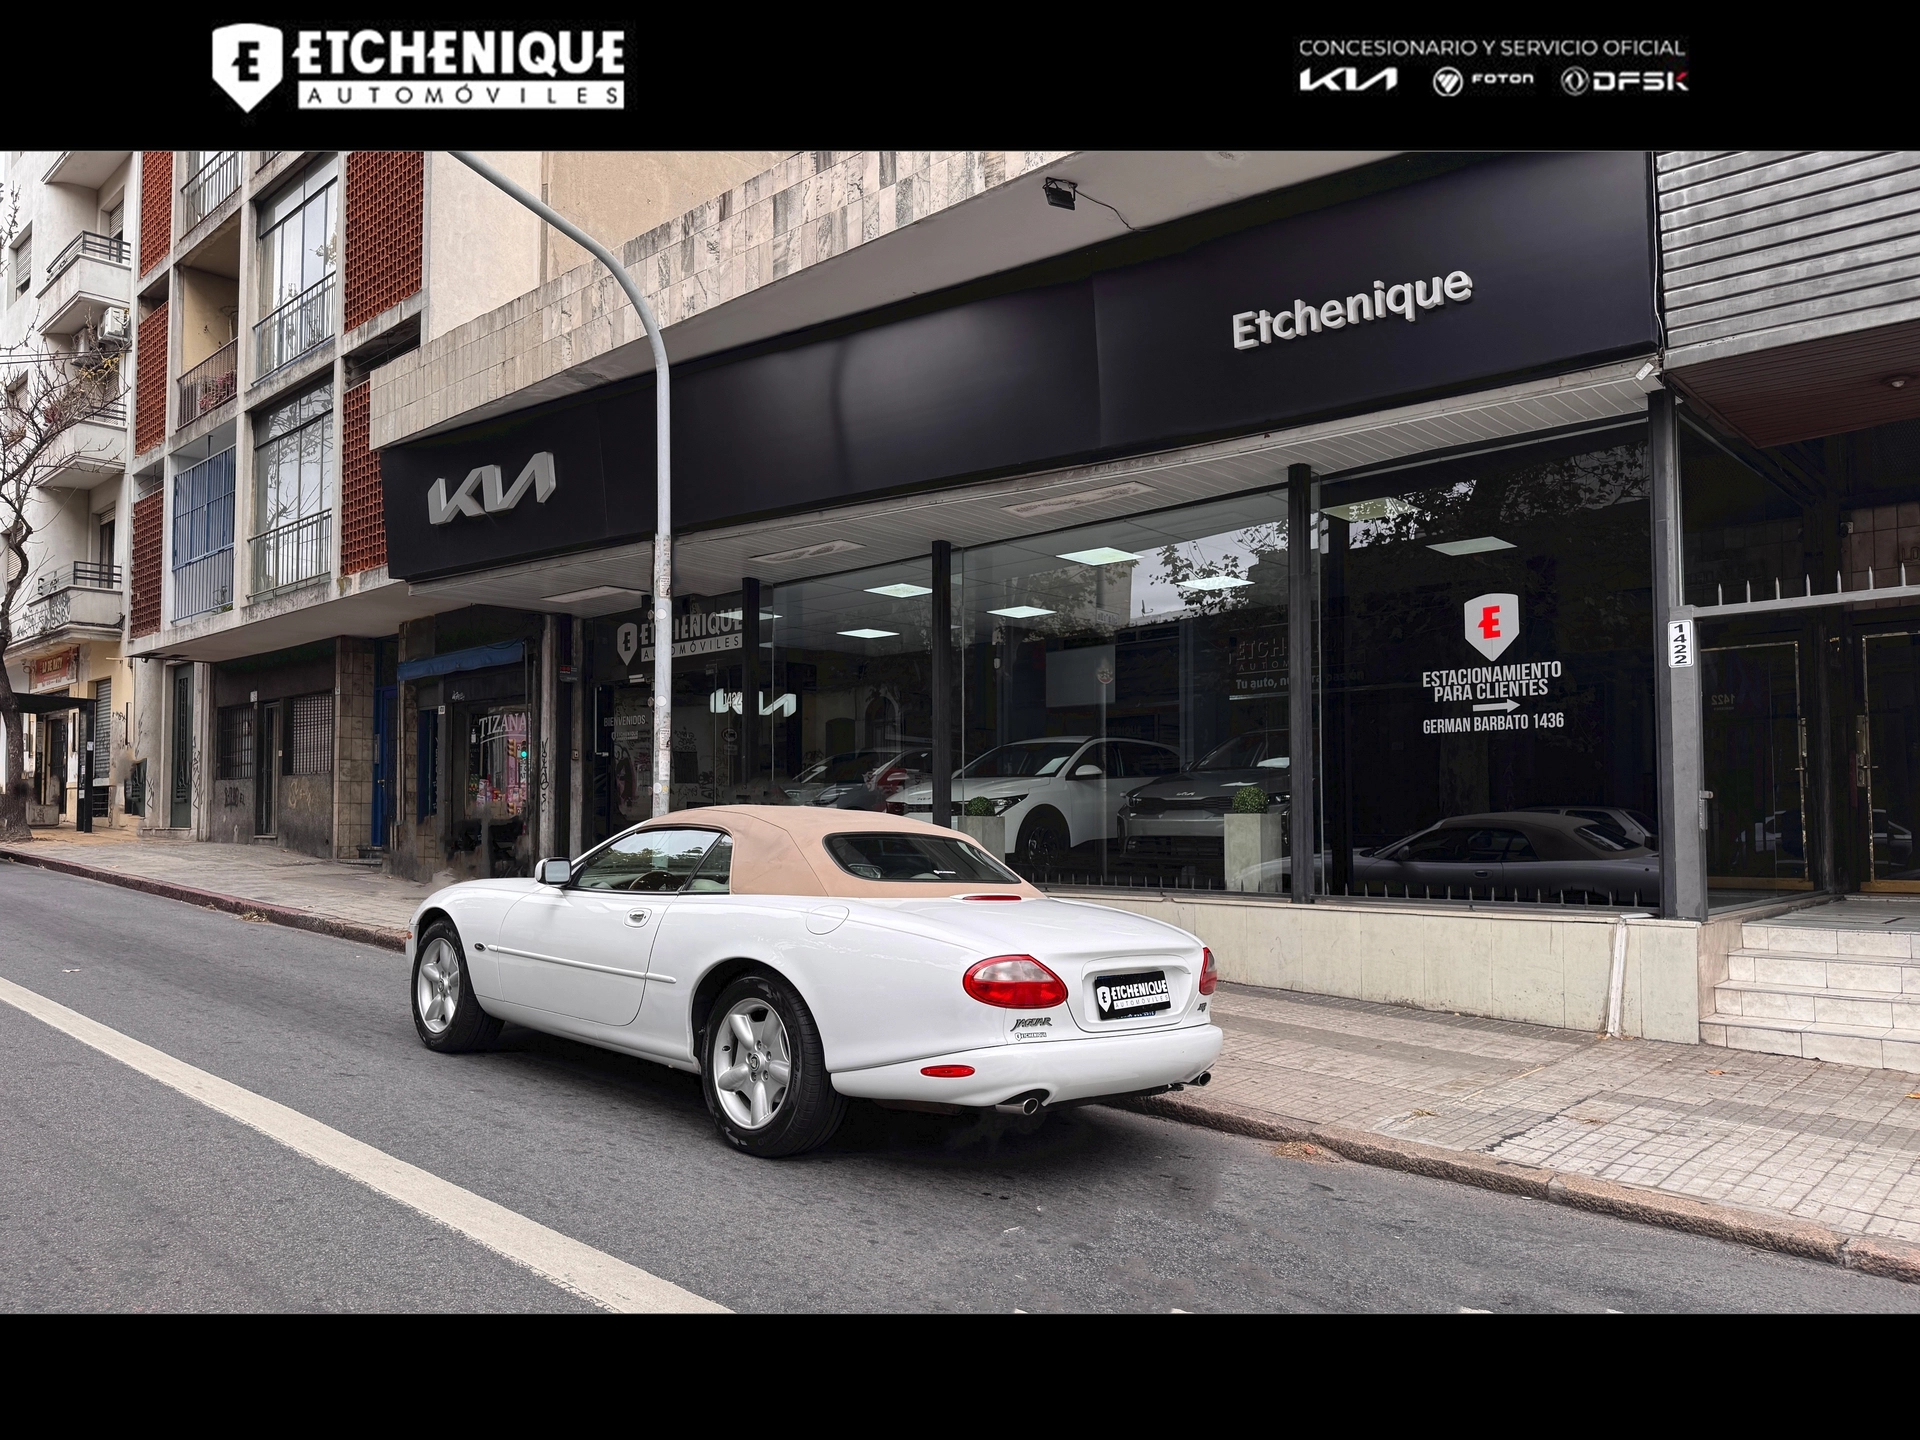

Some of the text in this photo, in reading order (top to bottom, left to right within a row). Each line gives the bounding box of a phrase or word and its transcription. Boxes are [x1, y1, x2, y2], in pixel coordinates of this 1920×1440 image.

[1232, 270, 1473, 350] Etchenique
[640, 608, 742, 645] ETENIQUE
[1673, 623, 1688, 665] 1422
[1236, 678, 1248, 690] Tu
[1422, 660, 1562, 688] ESTACIONAMIENTO
[1434, 678, 1549, 703] PARA CLIENTES
[478, 712, 526, 738] TIZANA
[604, 715, 646, 727] BIENVENIDOS
[1423, 712, 1565, 734] GERMAN BARBATO 1436
[1111, 979, 1168, 1000] ETCHENIQUE
[1010, 1017, 1053, 1032] JAGUAR
